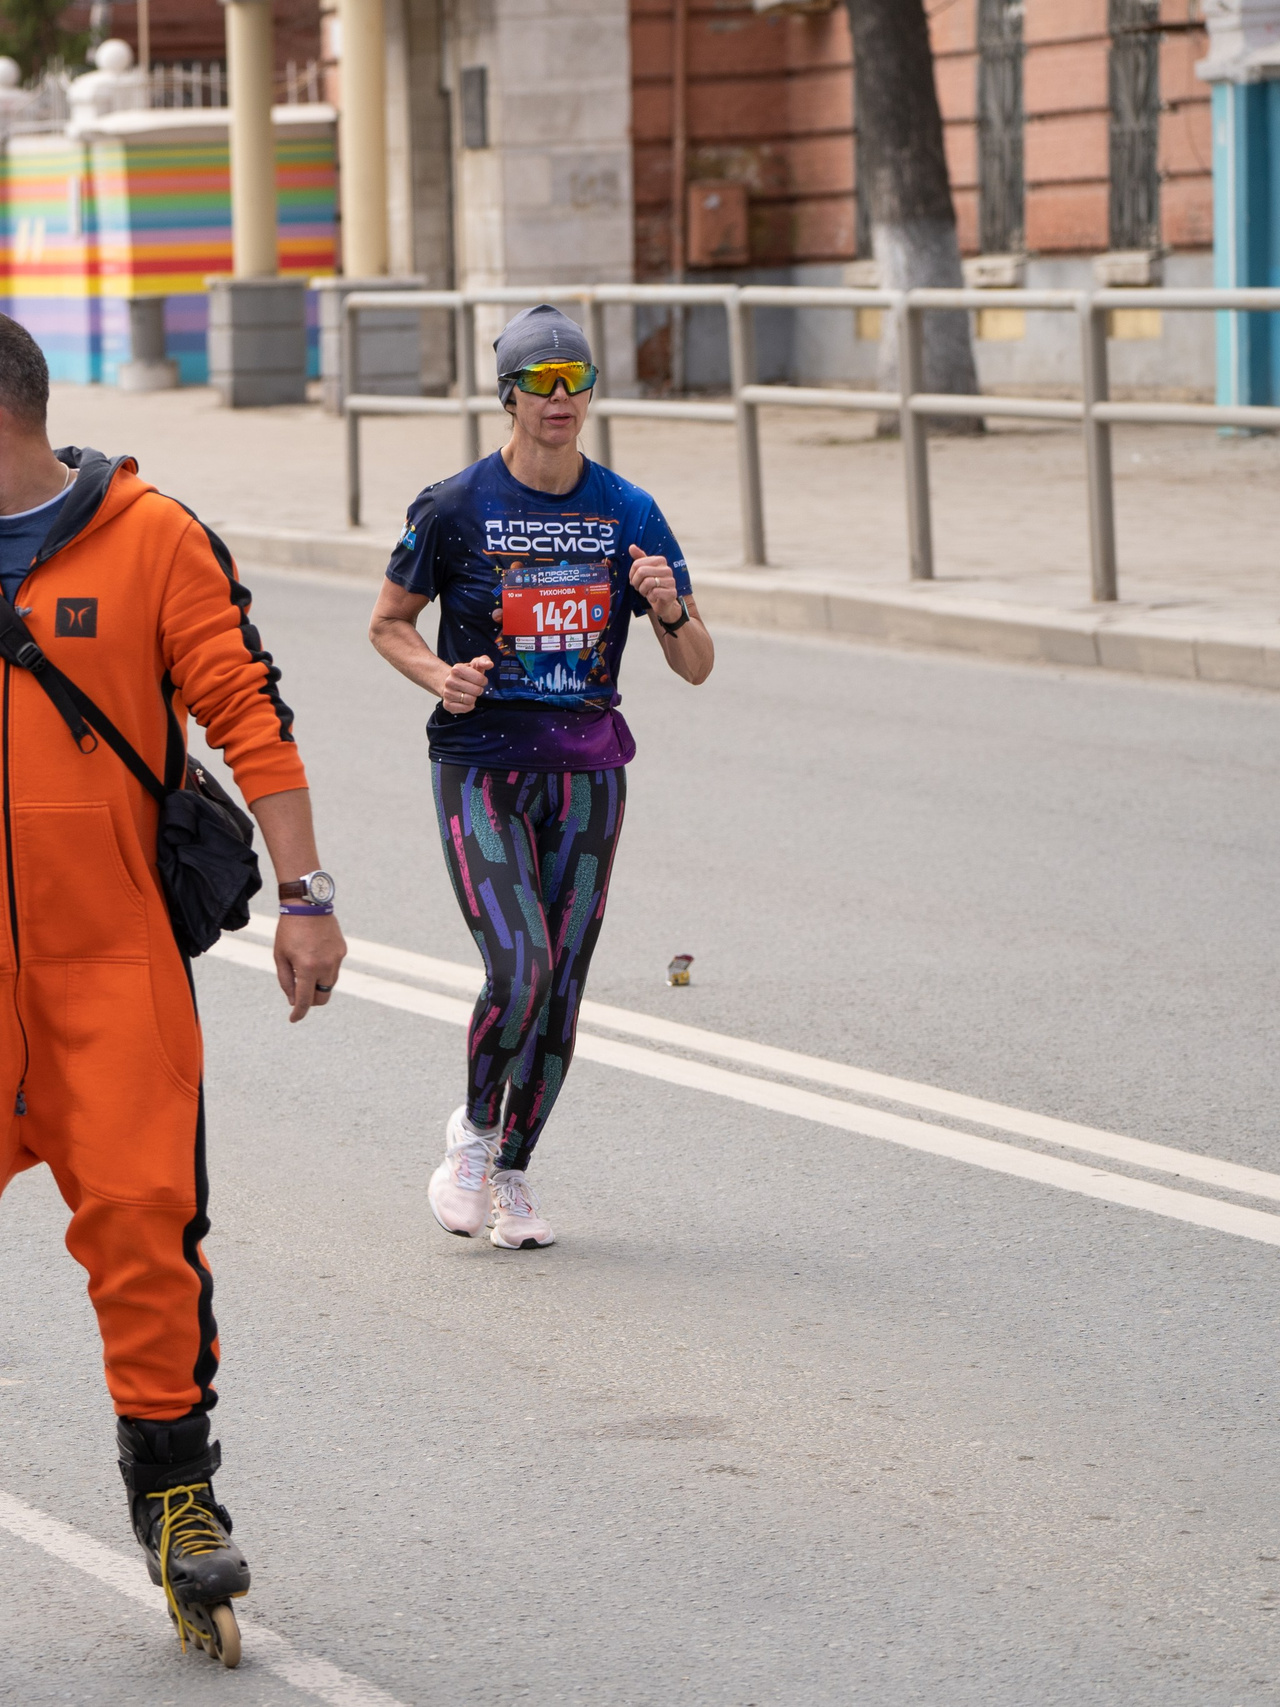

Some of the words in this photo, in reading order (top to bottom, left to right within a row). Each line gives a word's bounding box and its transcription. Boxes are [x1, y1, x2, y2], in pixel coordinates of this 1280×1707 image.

[485, 520, 503, 532] Я
[508, 520, 613, 537] ПРОСТО
[486, 535, 615, 556] КОСМОС
[545, 569, 579, 577] ПРОСТО
[538, 575, 580, 583] КОСМОС
[539, 588, 576, 596] ТИХОНОВА
[533, 599, 588, 632] 1421
[594, 608, 602, 618] D
